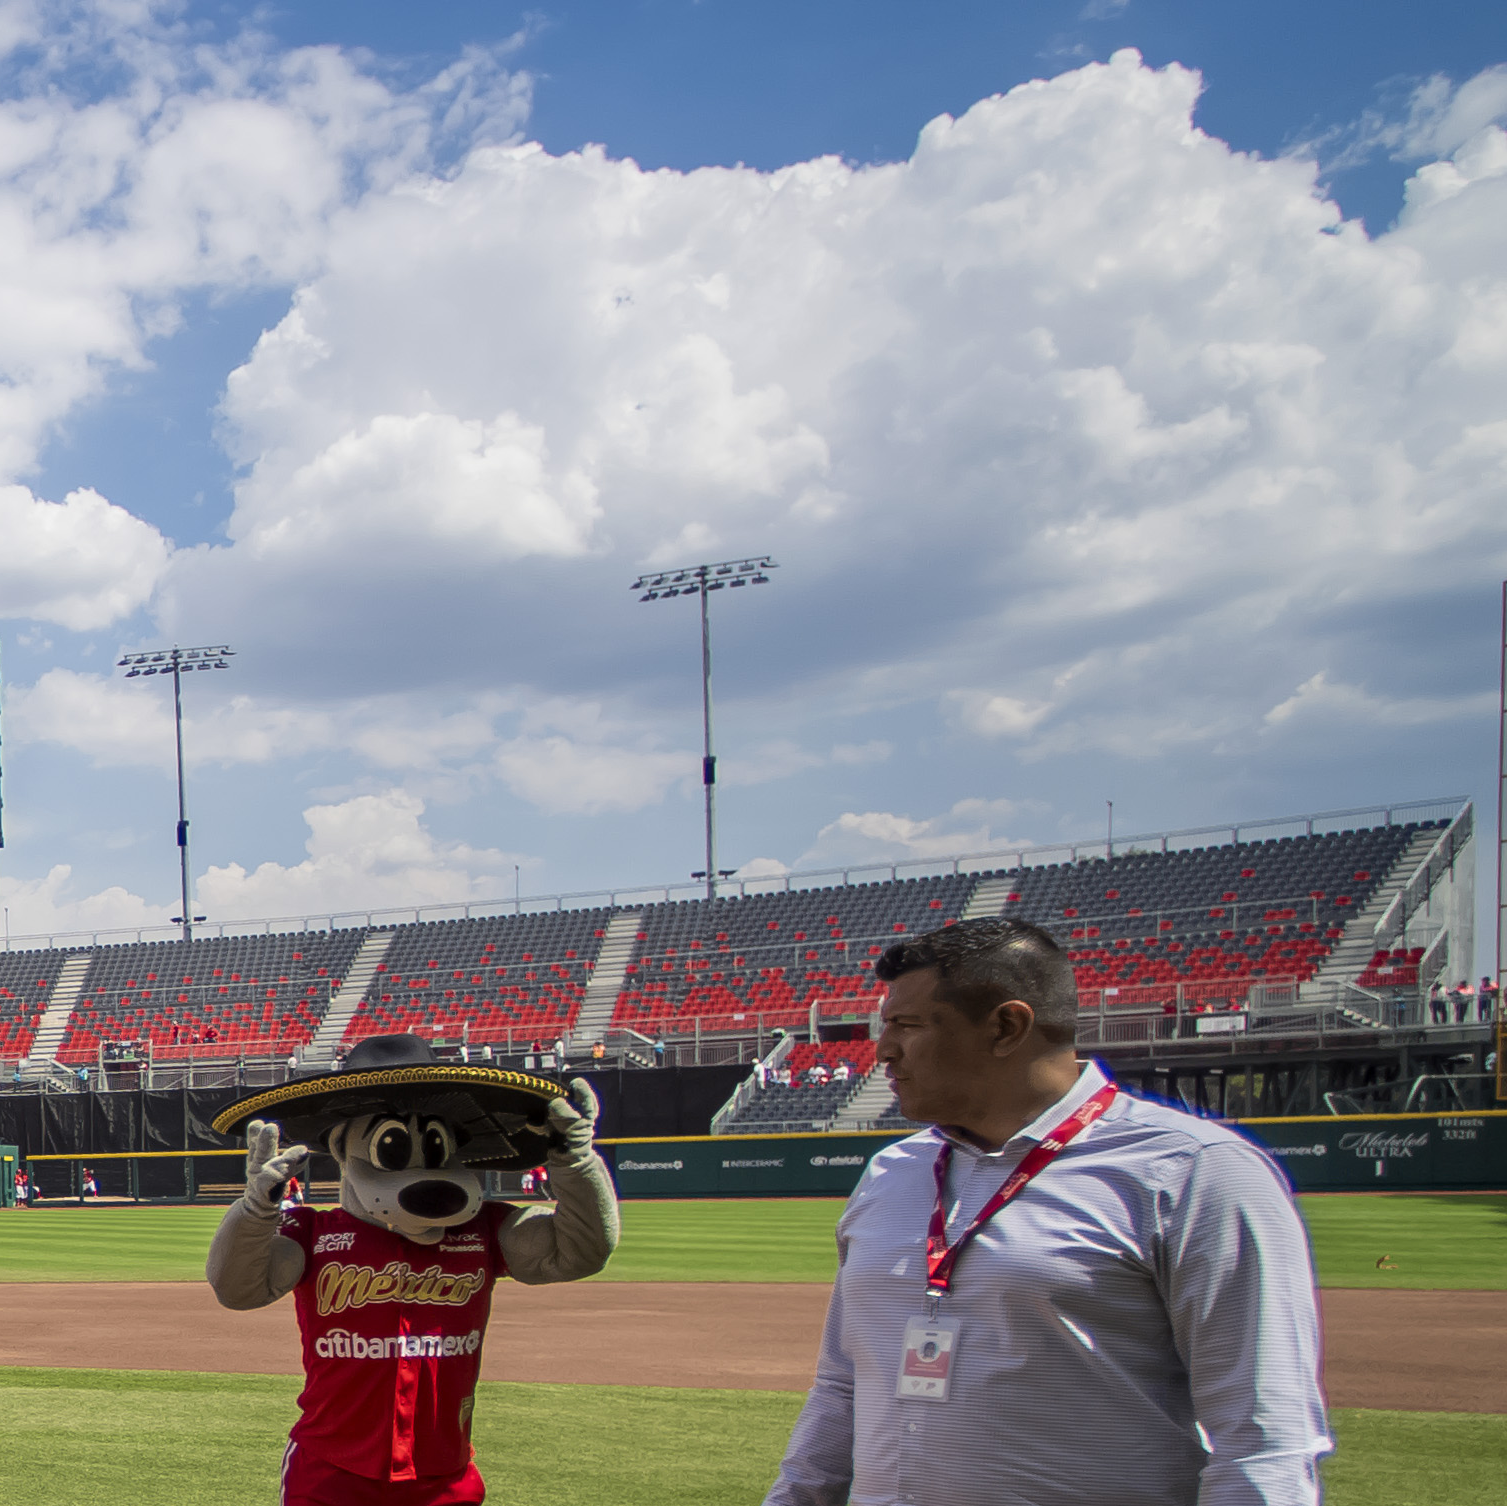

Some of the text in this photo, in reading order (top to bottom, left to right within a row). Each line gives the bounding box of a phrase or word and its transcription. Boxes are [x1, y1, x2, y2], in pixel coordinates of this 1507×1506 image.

[318, 1232, 357, 1244] SPORT
[326, 1240, 356, 1251] CITY
[316, 1261, 485, 1316] México
[315, 1328, 467, 1358] citibanamex
